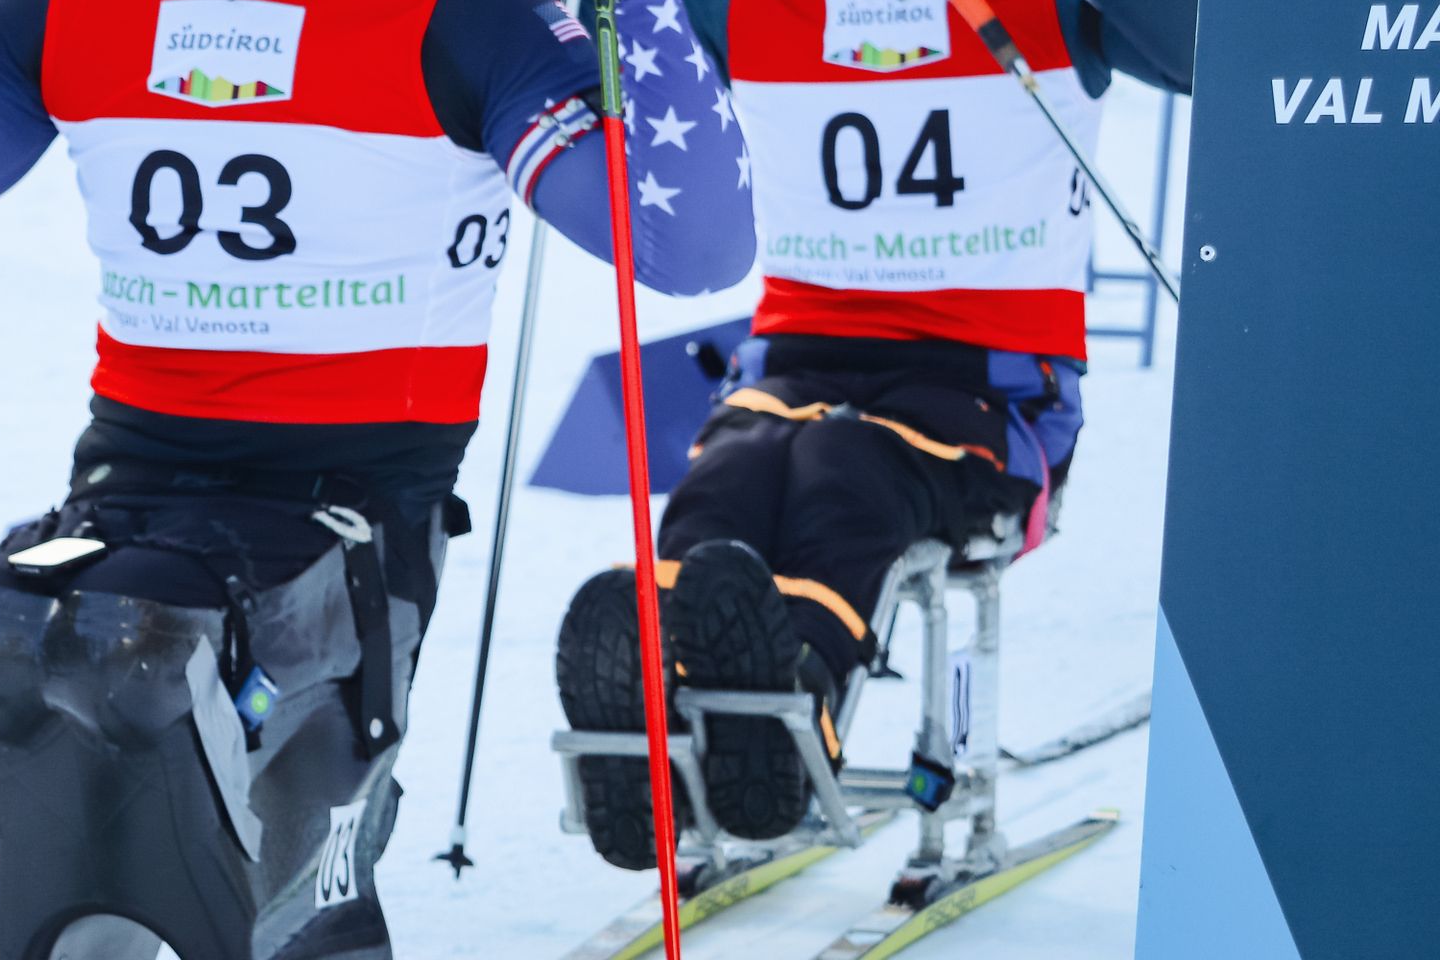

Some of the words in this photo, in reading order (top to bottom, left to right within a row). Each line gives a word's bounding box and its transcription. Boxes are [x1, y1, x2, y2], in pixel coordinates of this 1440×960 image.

[1361, 4, 1440, 51] MA
[1271, 77, 1383, 124] VAL
[821, 108, 965, 210] 04
[130, 149, 297, 261] 03
[1070, 167, 1090, 216] 0
[447, 208, 510, 268] 03
[875, 220, 1046, 260] Martelltal
[187, 274, 405, 309] Martelltal
[151, 315, 179, 332] Val
[186, 318, 270, 334] Venosta
[322, 818, 354, 902] 03
